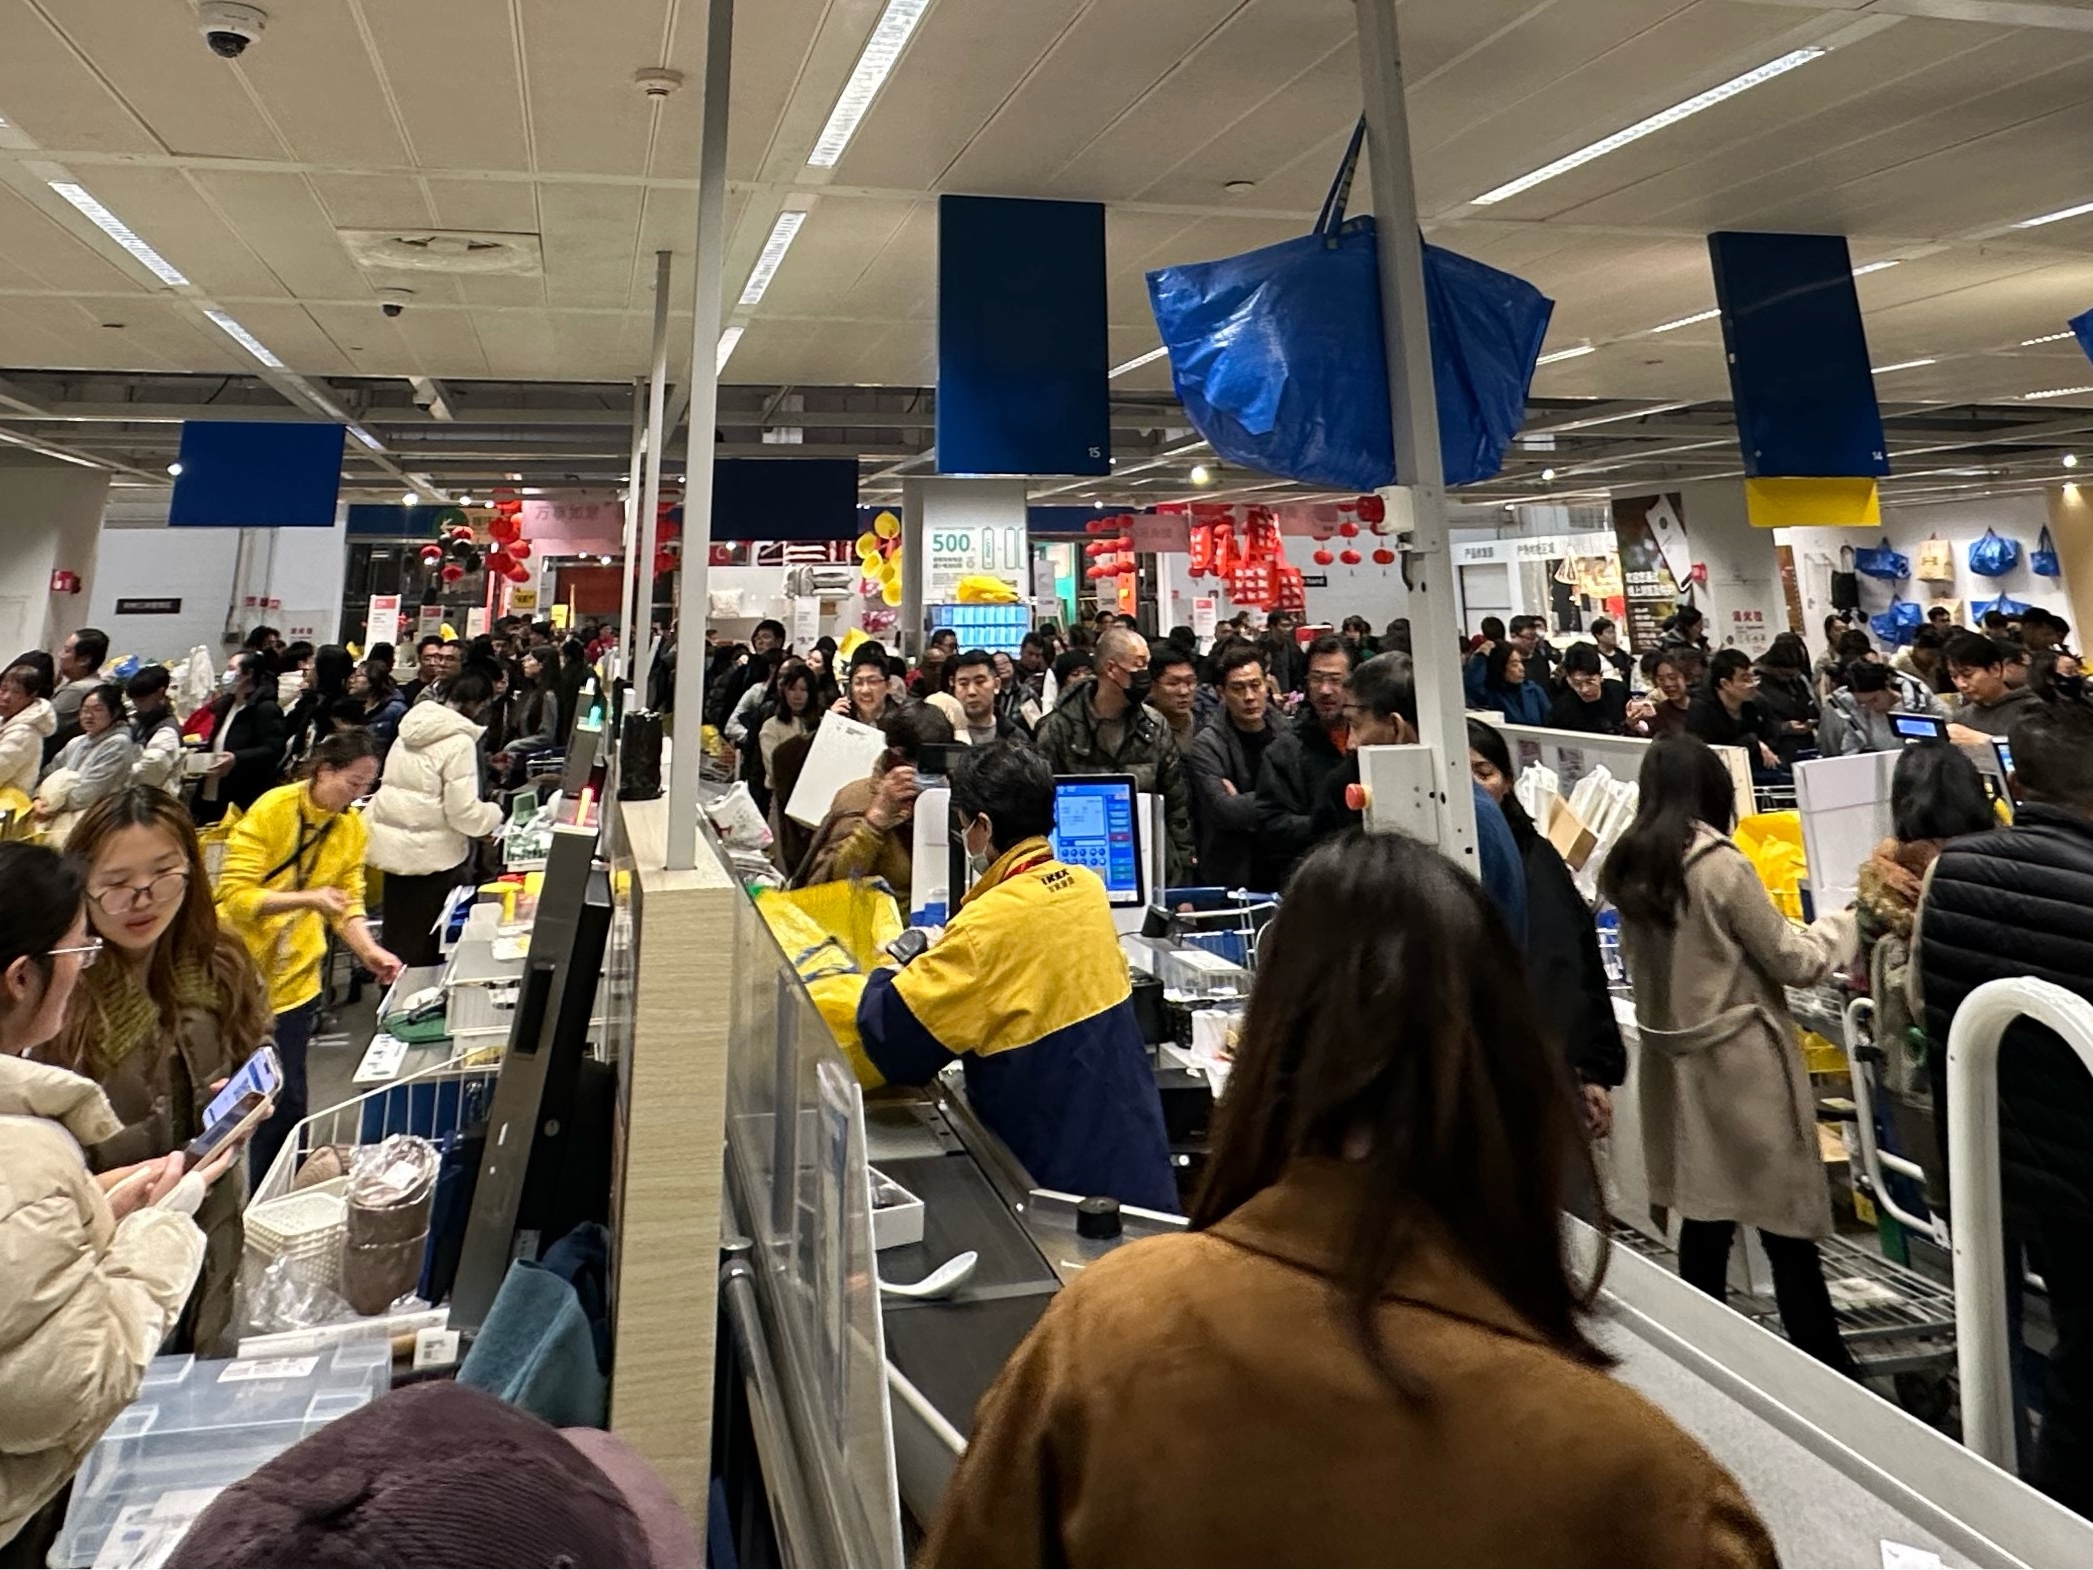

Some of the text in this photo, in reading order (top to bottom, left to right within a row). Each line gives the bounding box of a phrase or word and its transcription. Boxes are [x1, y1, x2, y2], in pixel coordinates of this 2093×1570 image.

[1088, 446, 1101, 458] 15
[1872, 451, 1883, 460] 14
[932, 533, 970, 552] 500
